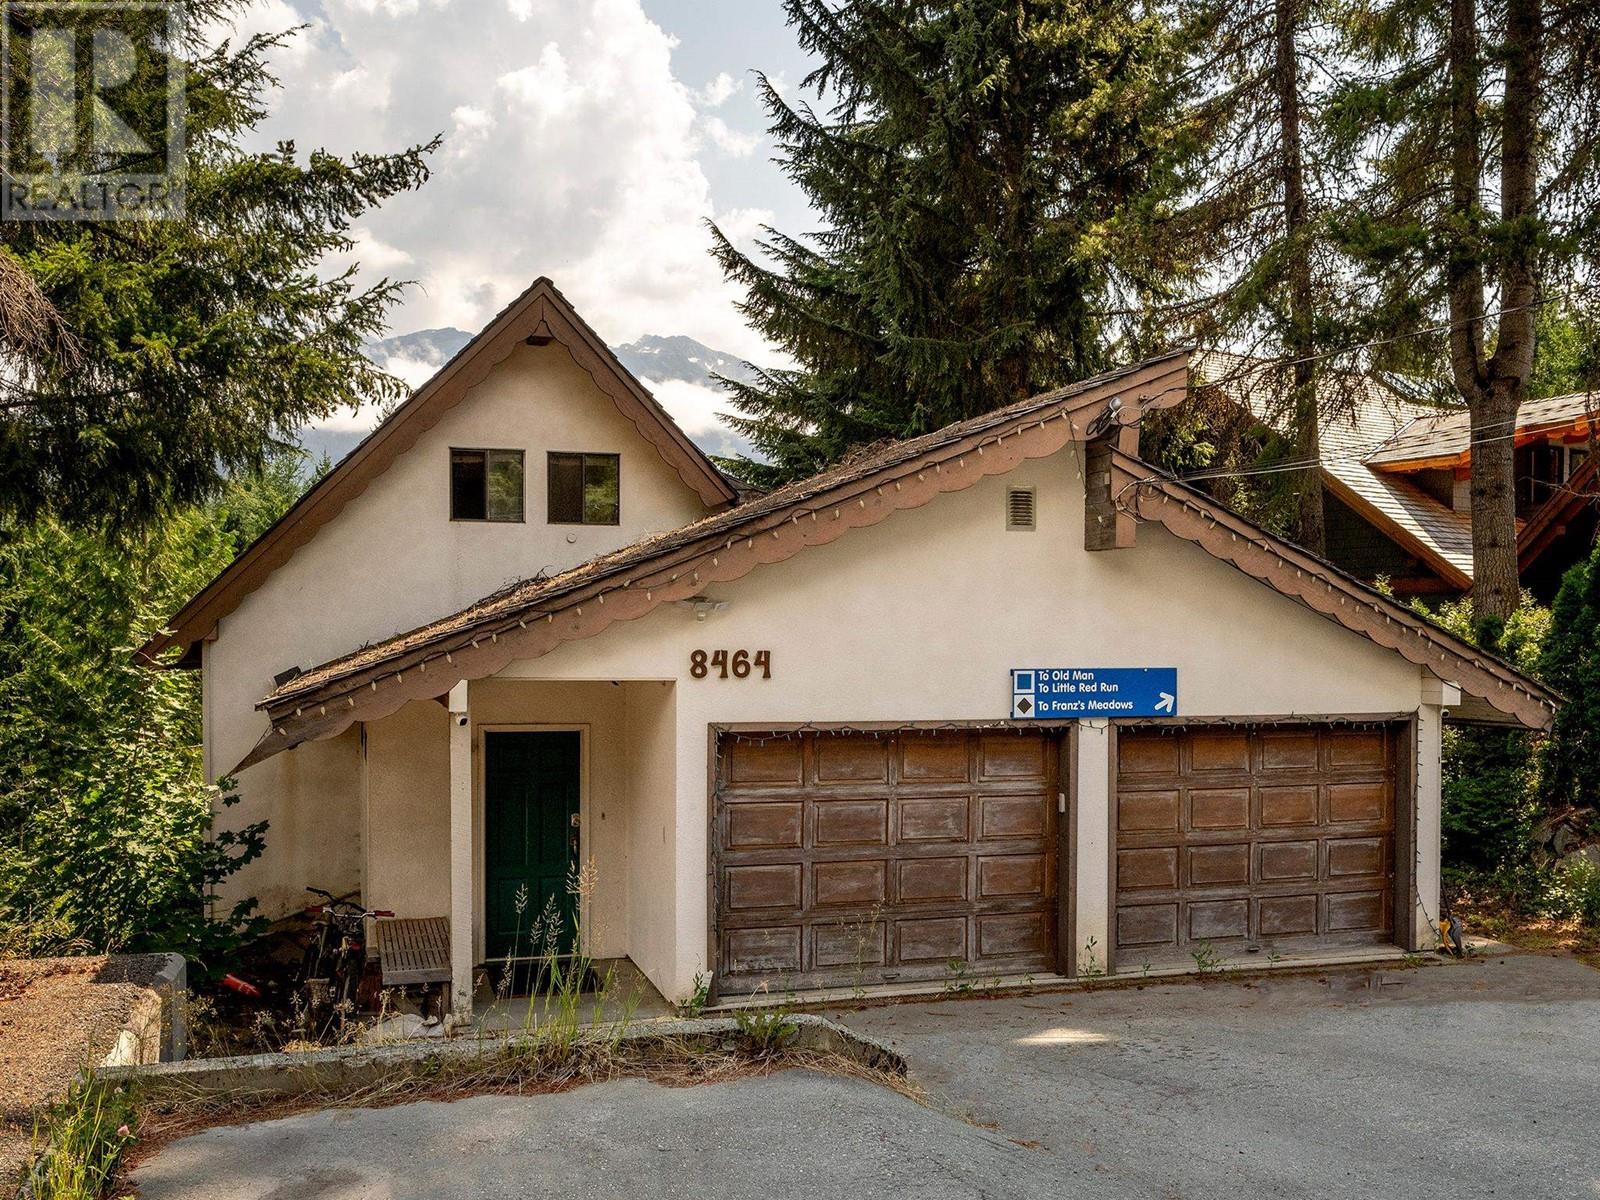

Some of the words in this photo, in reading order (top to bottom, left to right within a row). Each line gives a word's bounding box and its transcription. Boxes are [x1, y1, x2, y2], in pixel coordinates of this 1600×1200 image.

[690, 649, 771, 679] 8464
[1038, 670, 1049, 680] To
[1052, 670, 1069, 680] Old
[1072, 670, 1094, 680] Man
[1038, 683, 1049, 693] To
[1052, 682, 1076, 693] Little
[1079, 682, 1097, 692] Red
[1100, 682, 1119, 692] Run
[1038, 701, 1049, 711] To
[1052, 700, 1085, 711] Franz's
[1088, 699, 1133, 710] Meadows
